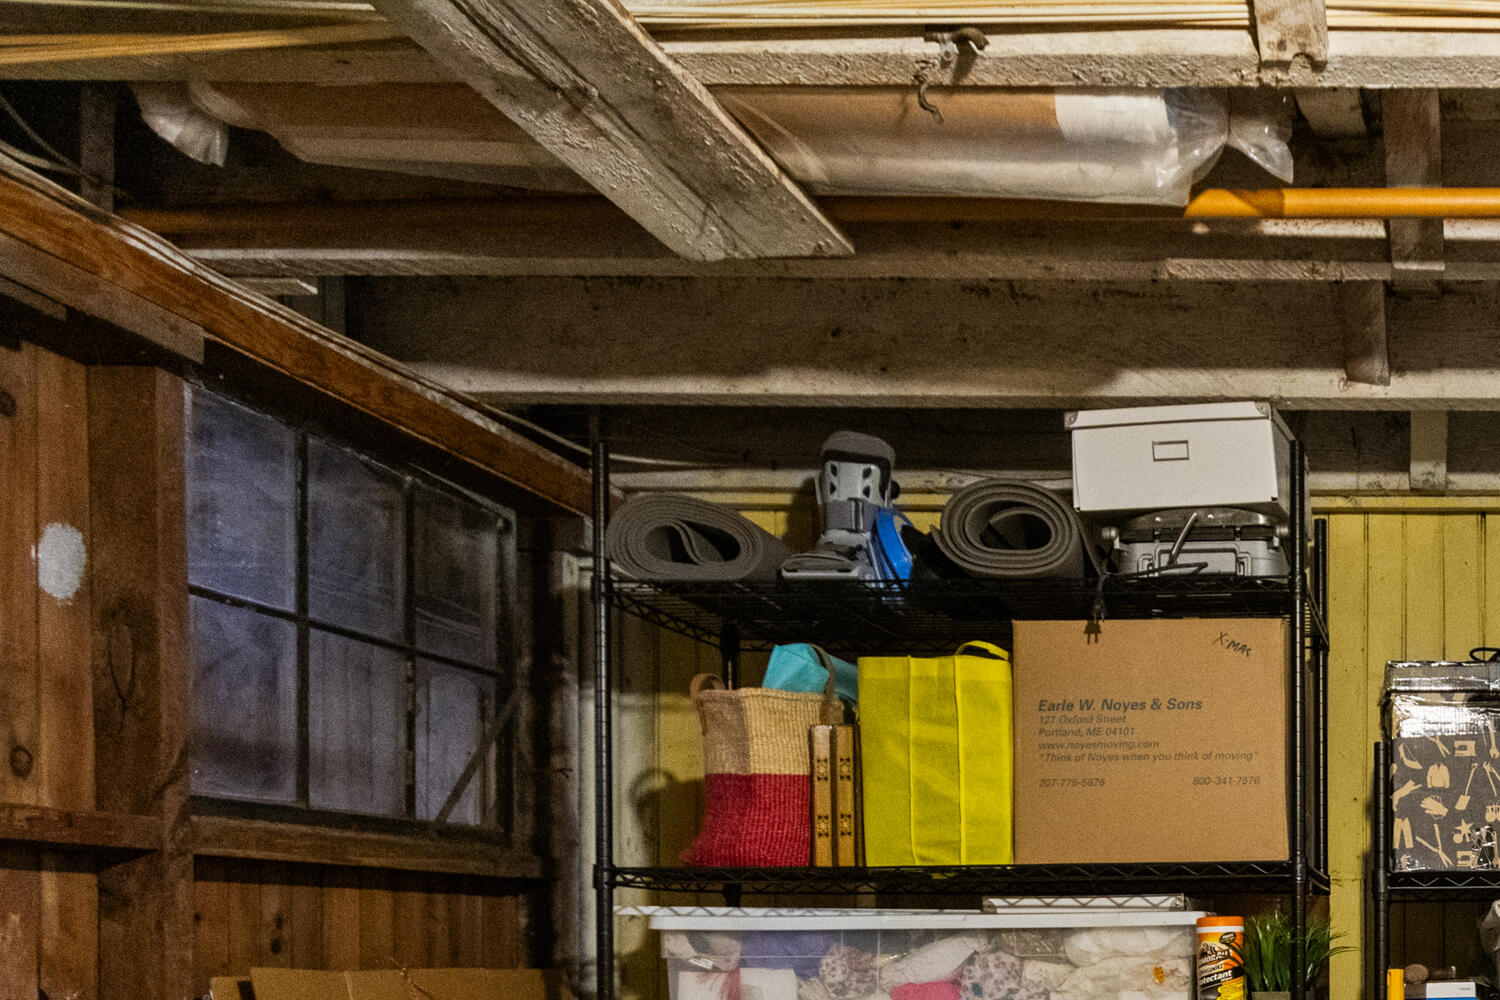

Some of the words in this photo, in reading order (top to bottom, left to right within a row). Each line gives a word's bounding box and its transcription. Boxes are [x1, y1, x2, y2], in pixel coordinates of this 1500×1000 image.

[1038, 700, 1074, 711] Earle
[1079, 699, 1096, 711] W.
[1101, 699, 1146, 713] Noyes
[1150, 698, 1162, 710] &
[1166, 698, 1203, 710] Sons
[1040, 715, 1056, 724] 127
[1058, 714, 1093, 724] Oxford
[1096, 714, 1126, 724] Street
[1038, 727, 1083, 737] Portland,
[1086, 727, 1103, 736] ME
[1105, 727, 1135, 736] 04101
[1038, 741, 1160, 750] www.noyesmoving.com
[1075, 753, 1085, 761] of
[1088, 753, 1120, 763] Noyes
[1122, 753, 1149, 761] when
[1152, 753, 1171, 762] you
[1174, 752, 1199, 760] think
[1202, 751, 1213, 760] of
